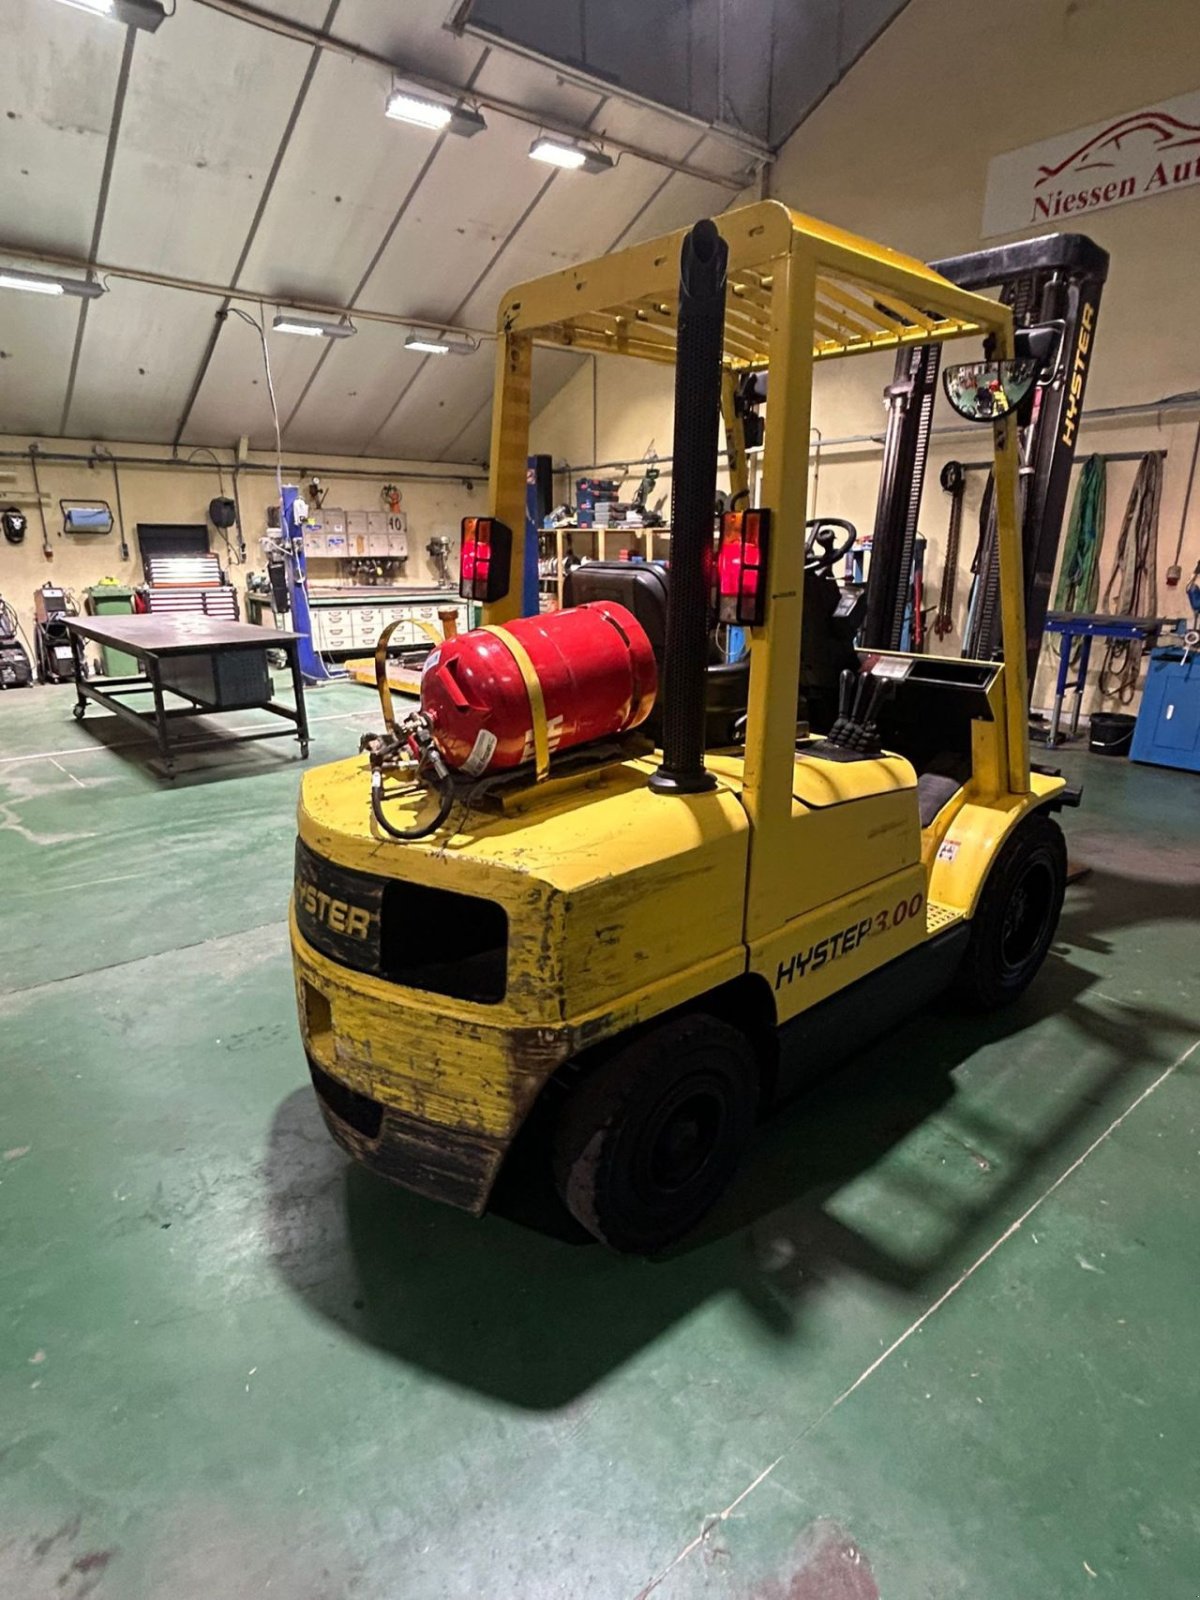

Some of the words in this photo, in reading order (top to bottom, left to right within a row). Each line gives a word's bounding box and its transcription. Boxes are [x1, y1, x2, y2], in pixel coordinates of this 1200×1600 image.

[1031, 175, 1136, 223] Niessen
[1062, 301, 1095, 447] HYSTER
[876, 893, 923, 931] 3.00
